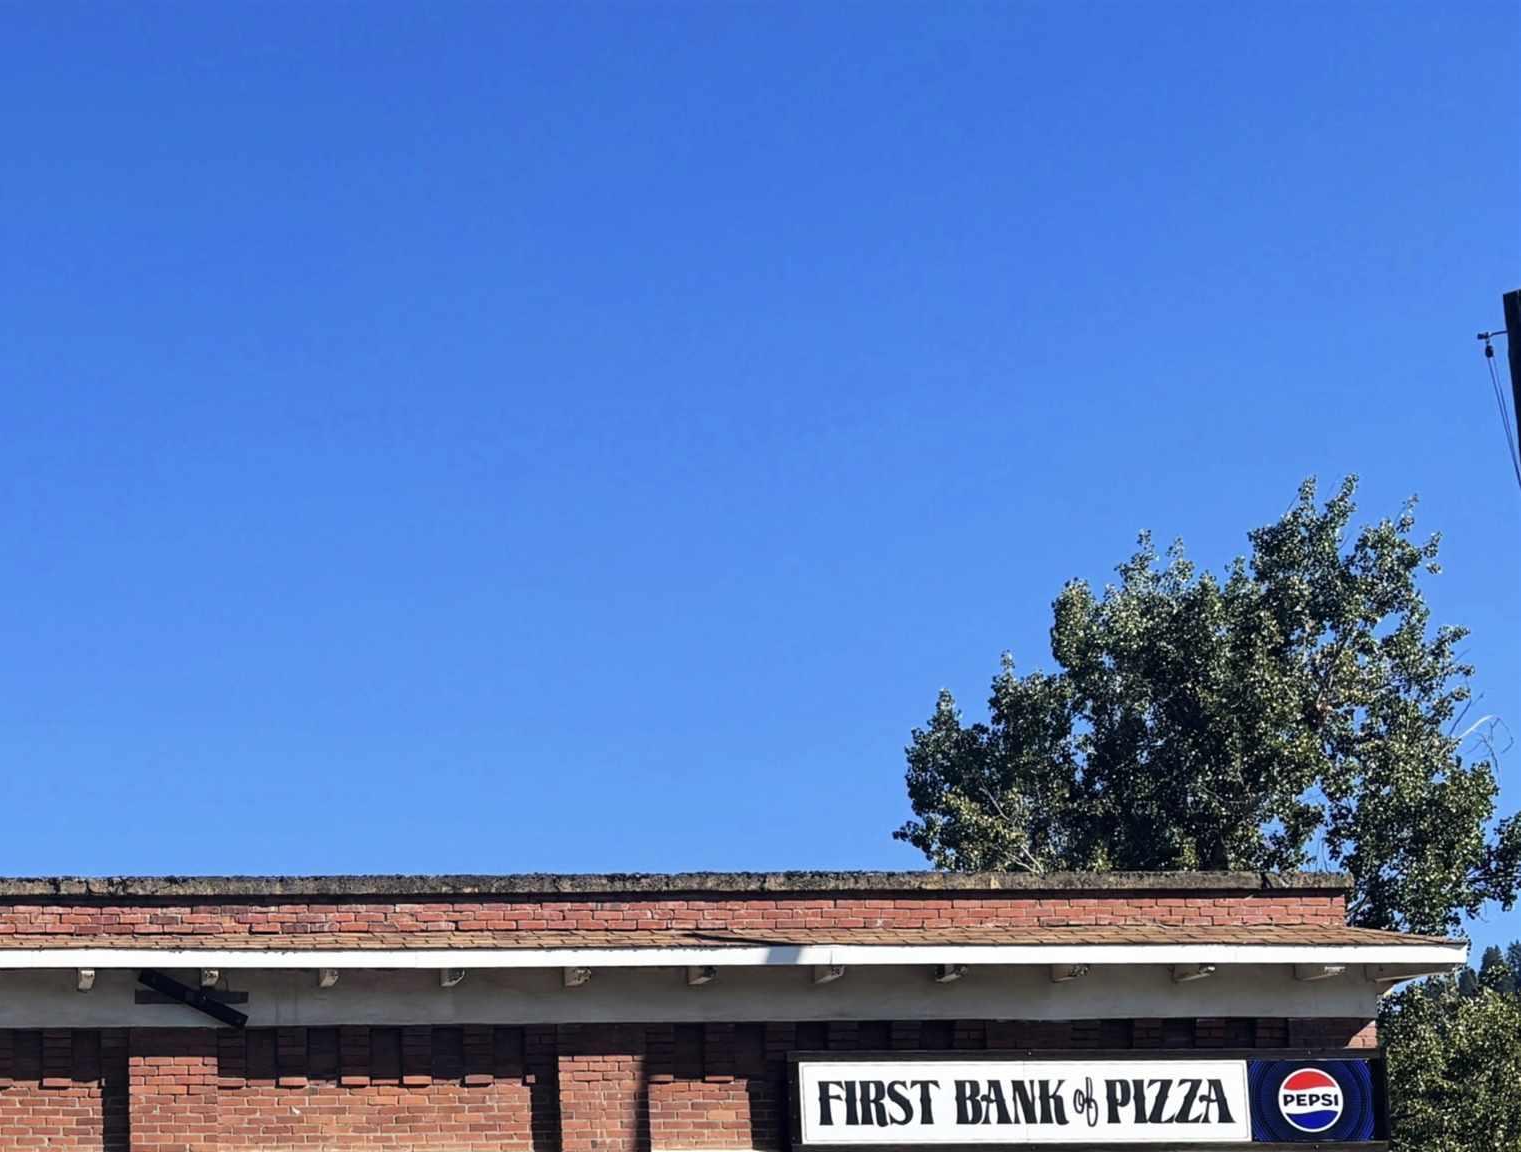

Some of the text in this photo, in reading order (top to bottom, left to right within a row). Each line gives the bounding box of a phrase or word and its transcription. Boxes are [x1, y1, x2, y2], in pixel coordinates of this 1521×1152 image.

[817, 1076, 1237, 1127] FIRST BANK of PIZZA
[1283, 1093, 1339, 1107] PEPSI
